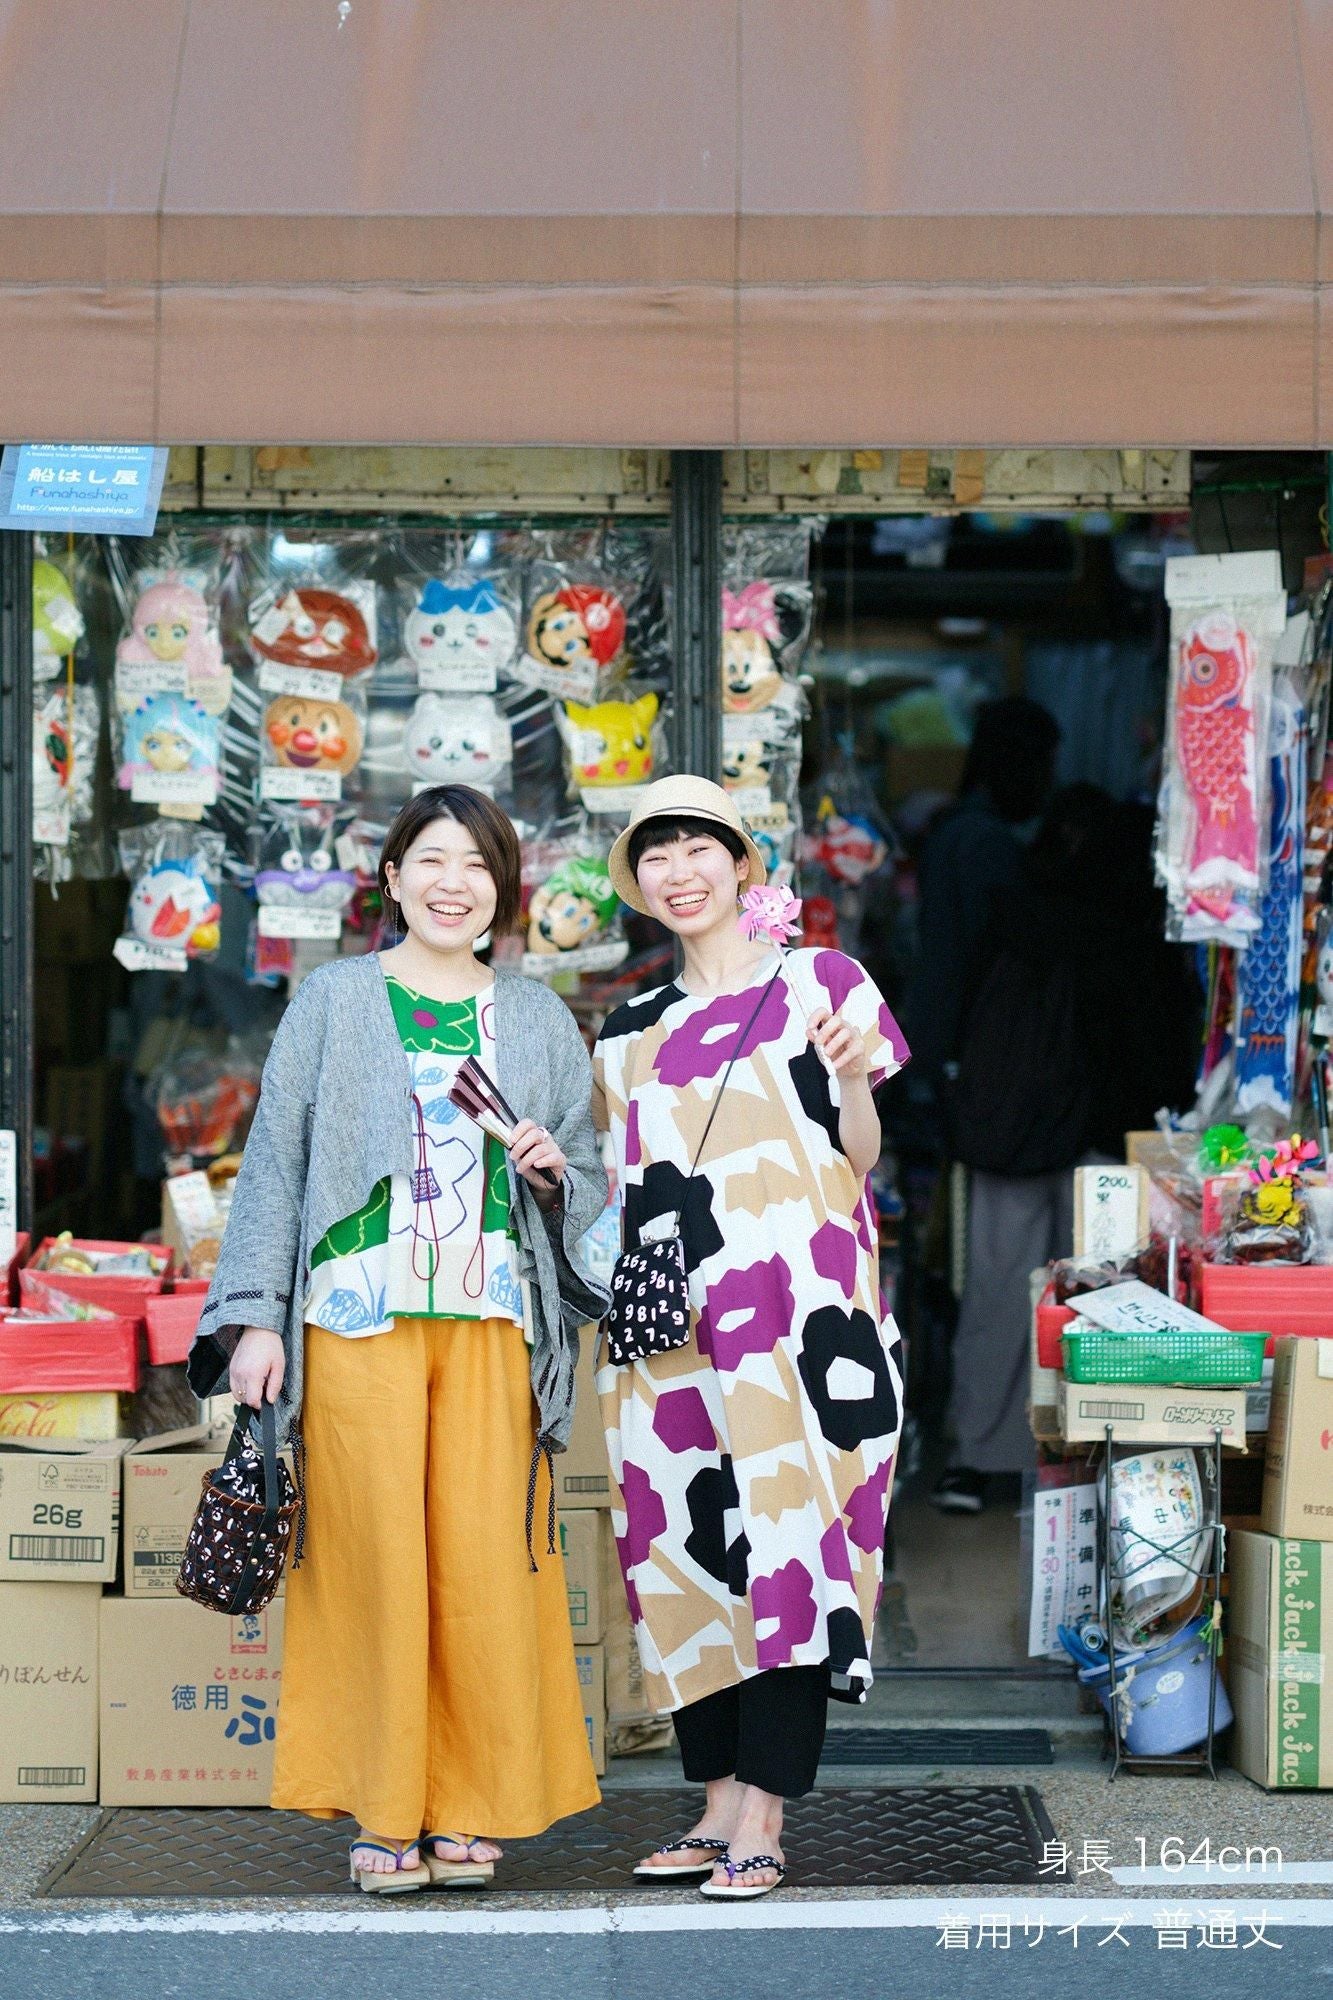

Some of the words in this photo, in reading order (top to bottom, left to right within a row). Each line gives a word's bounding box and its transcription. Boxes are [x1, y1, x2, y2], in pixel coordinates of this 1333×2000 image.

[27, 467, 140, 485] 船はし屋
[33, 1503, 83, 1529] 26g
[153, 1552, 183, 1565] 1136
[1284, 1541, 1309, 1588] ack
[171, 1684, 229, 1711] 徳用
